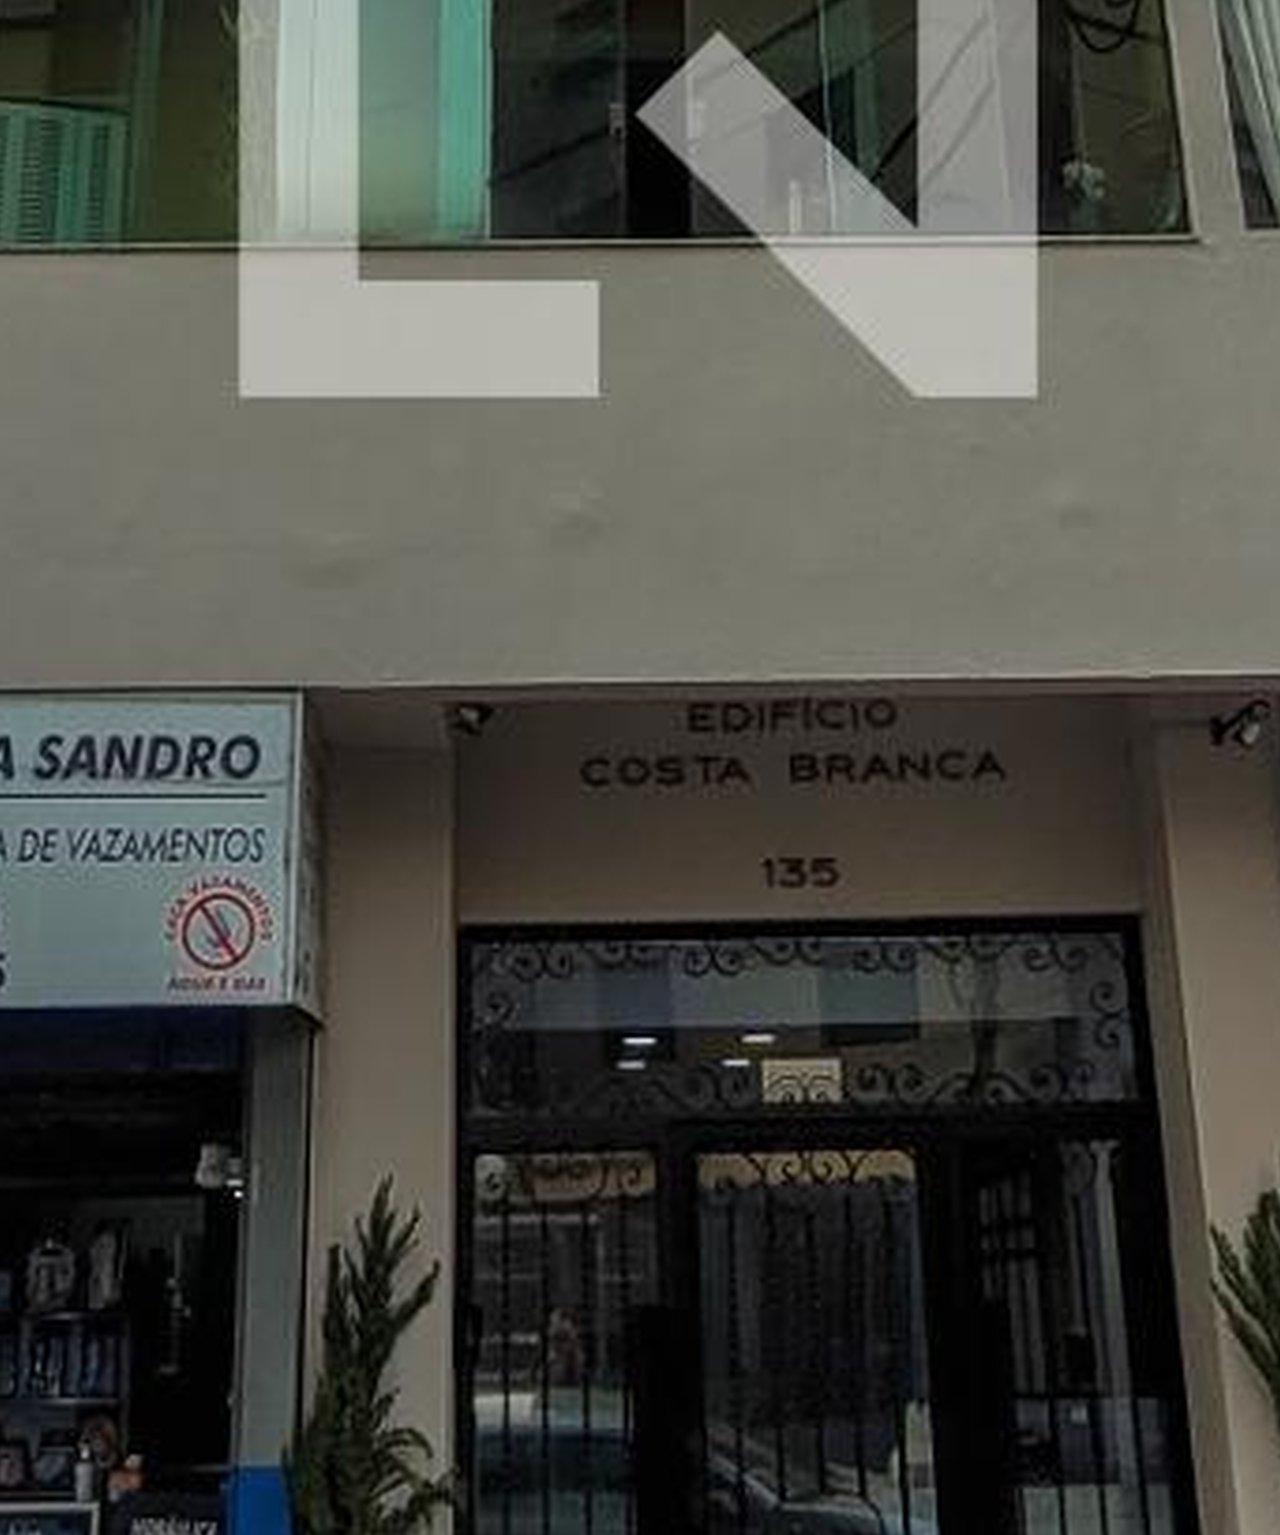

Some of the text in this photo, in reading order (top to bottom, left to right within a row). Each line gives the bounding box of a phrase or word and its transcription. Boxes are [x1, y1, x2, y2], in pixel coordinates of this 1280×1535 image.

[35, 734, 261, 779] SANDRO
[580, 750, 1006, 786] COSTA BRANCA
[18, 828, 58, 863] DE
[68, 827, 267, 863] VAZAMENTOS
[761, 856, 841, 889] 135
